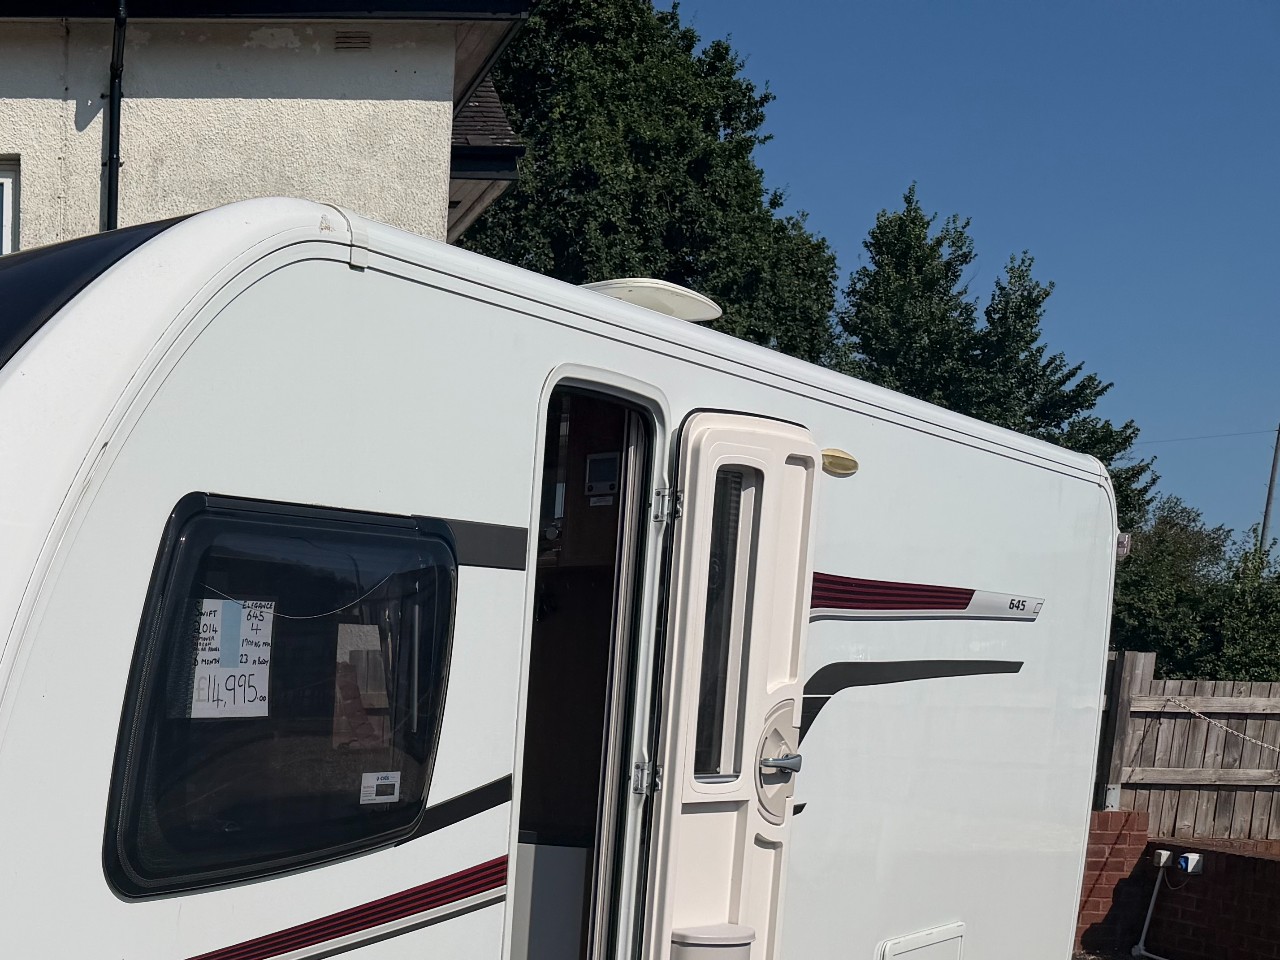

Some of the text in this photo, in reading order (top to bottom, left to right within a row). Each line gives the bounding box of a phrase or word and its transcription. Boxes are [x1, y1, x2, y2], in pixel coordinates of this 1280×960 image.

[1008, 598, 1027, 611] 645
[246, 609, 265, 622] 645
[194, 621, 218, 634] 2014
[250, 622, 261, 635] 4
[239, 653, 249, 664] 23
